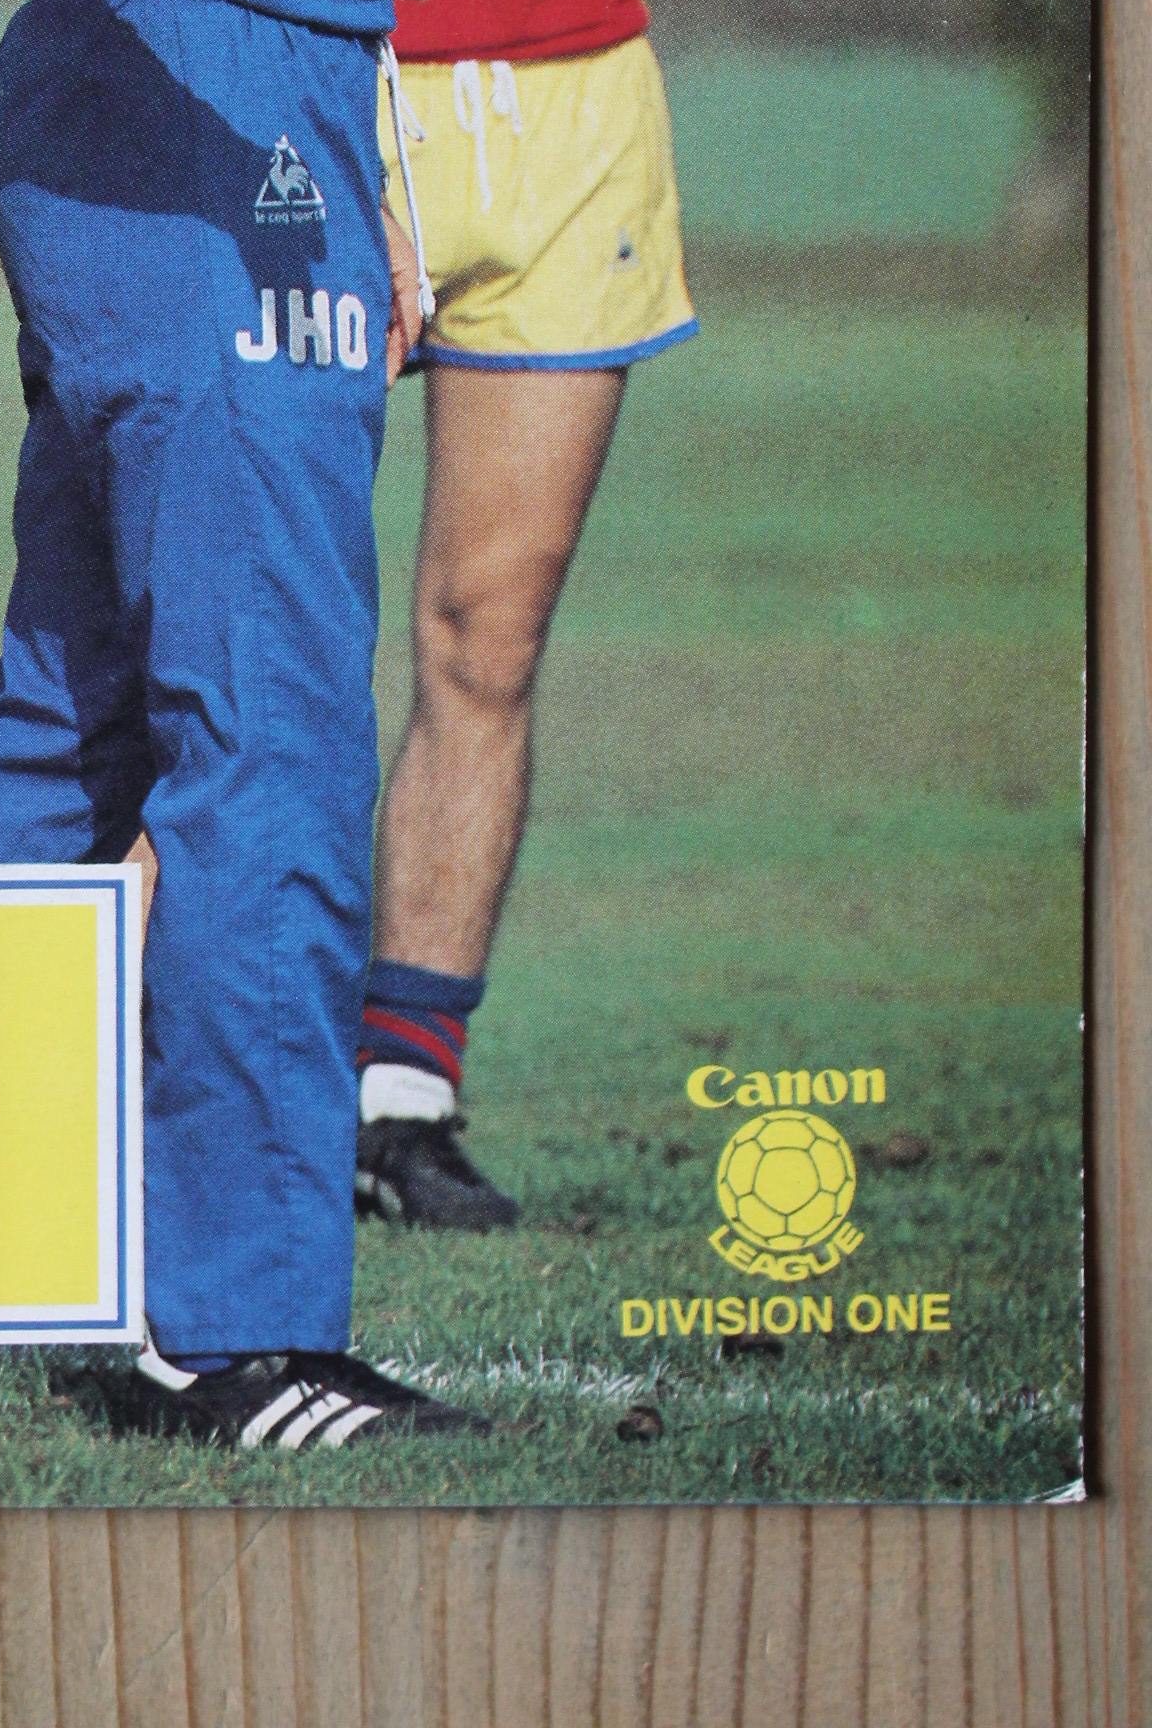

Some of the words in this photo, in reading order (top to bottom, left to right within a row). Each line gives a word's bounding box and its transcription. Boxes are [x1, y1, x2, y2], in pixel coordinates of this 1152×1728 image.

[235, 288, 369, 370] JHO
[687, 1065, 886, 1109] Canon
[709, 1221, 866, 1282] LEAGUE
[622, 1296, 832, 1336] DIVISION
[848, 1294, 950, 1332] ONE
